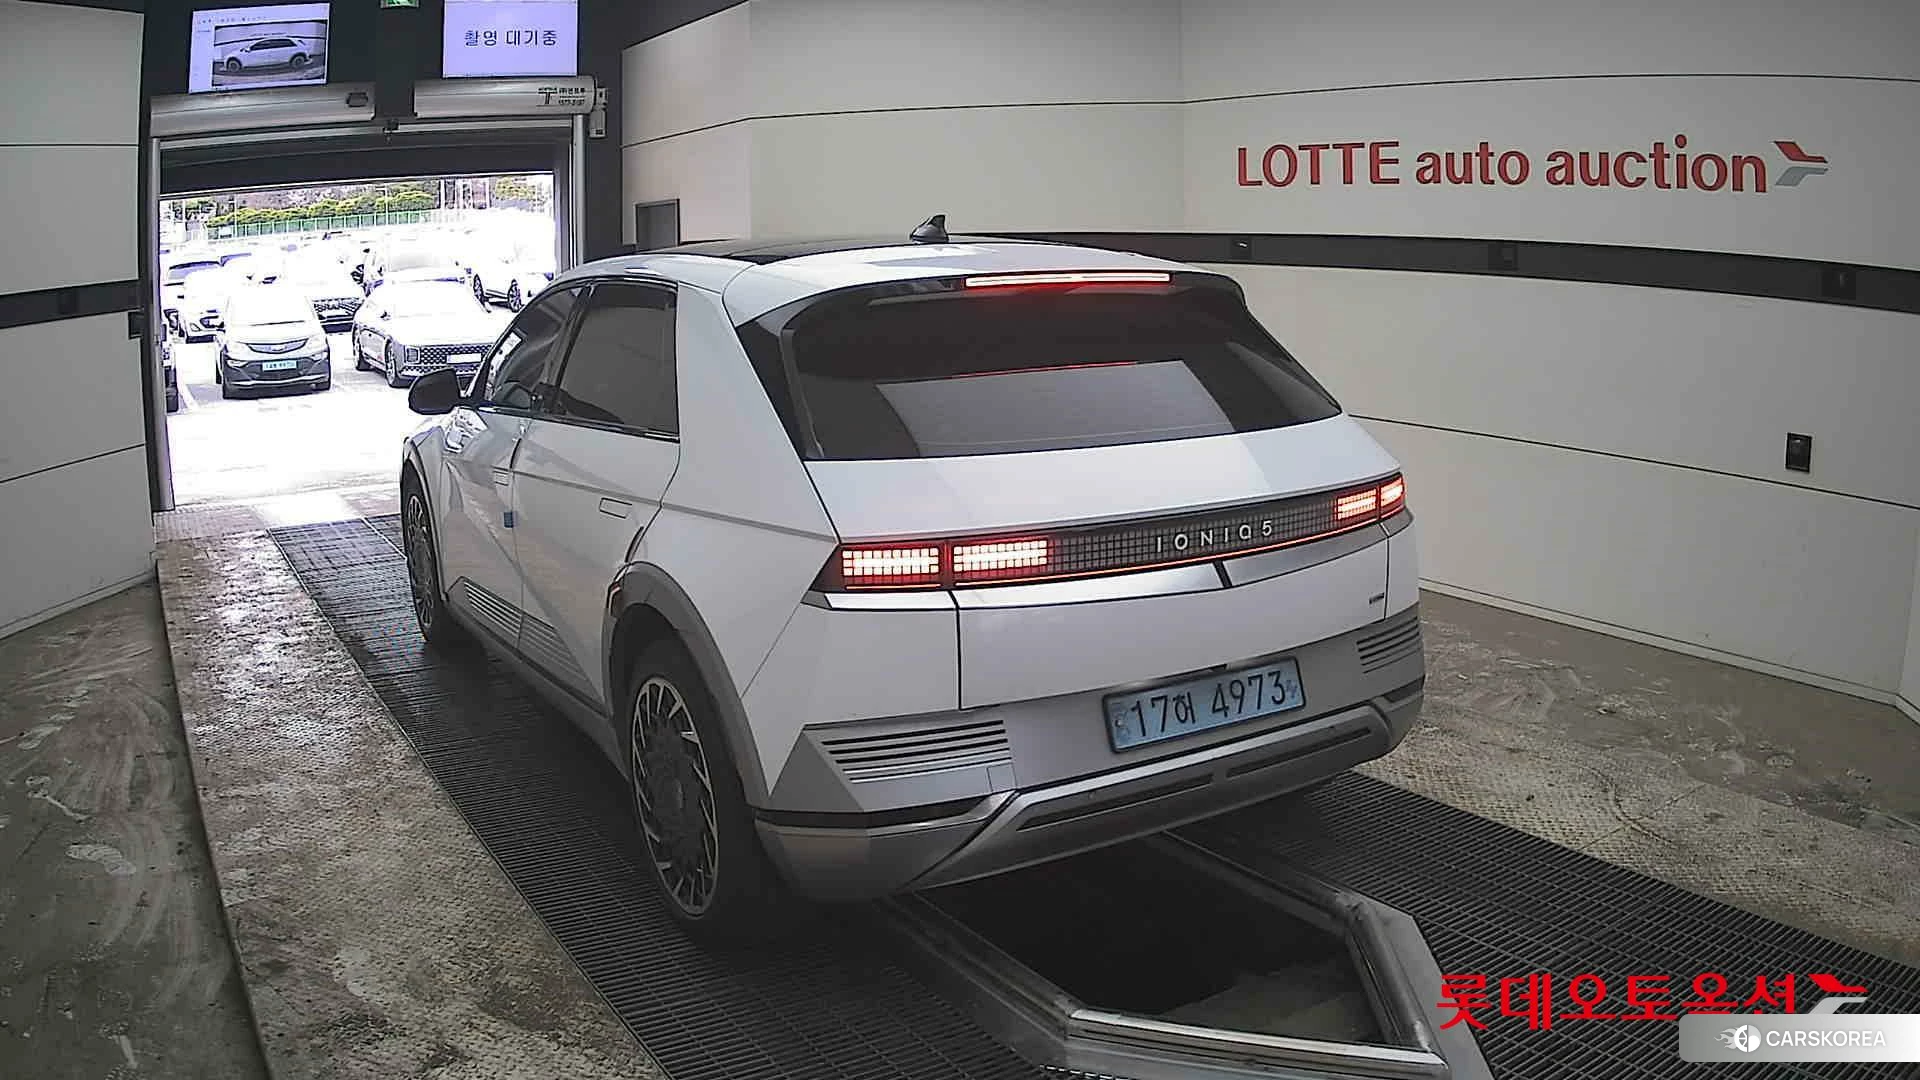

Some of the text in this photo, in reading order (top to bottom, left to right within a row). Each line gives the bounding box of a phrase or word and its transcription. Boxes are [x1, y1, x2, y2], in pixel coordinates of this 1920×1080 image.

[464, 29, 558, 47] 촬영 대기중
[1237, 133, 1767, 193] LOTTE auto auction
[1130, 670, 1287, 737] 17허 4973
